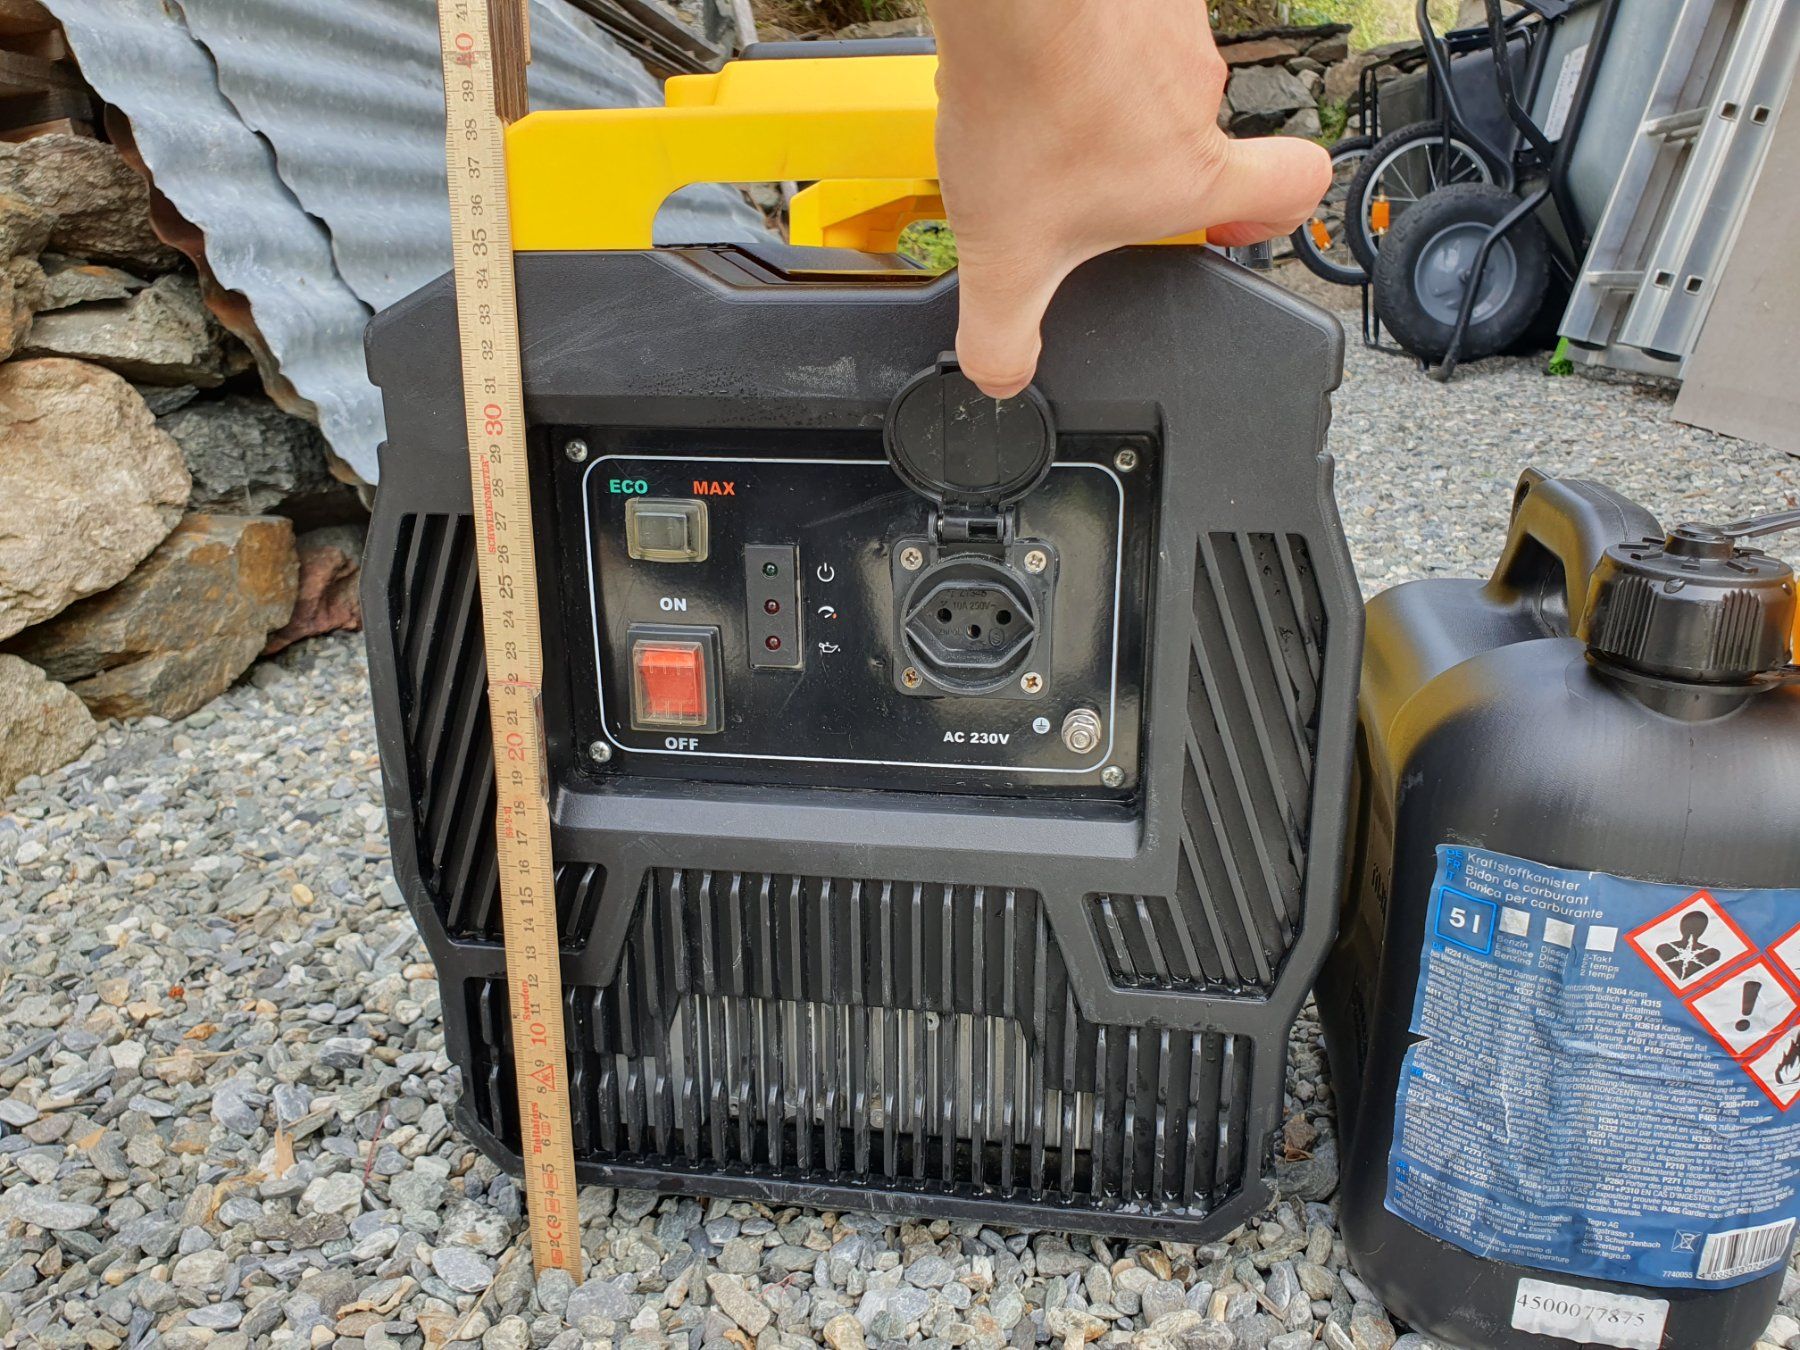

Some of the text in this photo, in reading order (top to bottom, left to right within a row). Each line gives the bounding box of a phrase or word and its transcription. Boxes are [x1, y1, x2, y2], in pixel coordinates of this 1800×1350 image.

[457, 2, 468, 20] 41
[455, 33, 475, 70] 40
[462, 80, 475, 102] 39
[466, 118, 478, 140] 38
[468, 157, 480, 179] 37
[471, 194, 483, 216] 36
[473, 229, 488, 256] 35
[478, 268, 489, 290] 34
[480, 304, 491, 325] 33
[482, 340, 494, 361] 32
[485, 376, 496, 394] 31
[484, 403, 503, 436] 30
[490, 444, 501, 464] 29
[492, 478, 504, 497] 28
[610, 480, 648, 494] ECO
[692, 480, 736, 496] MAX
[495, 512, 506, 530] 27
[498, 545, 509, 563] 26
[498, 575, 514, 599] 25
[660, 597, 687, 611] ON
[503, 610, 514, 628] 24
[506, 642, 516, 660] 23
[507, 708, 518, 726] 21
[665, 737, 698, 750] OFF
[943, 732, 1010, 744] AC 230V
[506, 732, 526, 762] 20
[512, 770, 523, 788] 19
[514, 800, 525, 816] 18
[516, 830, 528, 846] 17
[519, 860, 530, 876] 16
[1447, 849, 1580, 891] DE Kraftstoffkanister
[1447, 859, 1589, 906] FR Bidon de carburant
[521, 887, 534, 906] 15
[1446, 871, 1603, 919] IT Tanica per carburante
[524, 917, 534, 933] 14
[1449, 907, 1466, 928] 5
[1497, 935, 1529, 949] Benzin
[526, 946, 536, 960] 13
[1494, 950, 1532, 966] Benzina
[1496, 943, 1534, 958] Essence
[1540, 946, 1569, 960] Diesel
[1583, 954, 1612, 963] 2-Takt
[1581, 960, 1620, 973] 2 temps
[528, 974, 538, 988] 12
[1498, 967, 1648, 998] und Dampf H304 Kann
[1590, 970, 1616, 980] tempi
[1484, 970, 1662, 1008] und Eindringen tödlich H315
[1514, 986, 1534, 997] H332
[521, 980, 531, 1021] Sweden
[1505, 992, 1663, 1023] und H340 Kann
[530, 1004, 540, 1016] 11
[1472, 997, 1487, 1006] Kind
[1594, 1026, 1613, 1034] Kann
[1628, 1029, 1655, 1039] Organe
[1656, 1032, 1694, 1042] schädigen
[1535, 1008, 1681, 1033] H350 H361d Kann
[530, 1023, 546, 1047] 10
[1626, 1037, 1646, 1045] P101
[1644, 1046, 1664, 1055] P102
[1665, 1050, 1682, 1058] Darf
[539, 1112, 548, 1120] 7
[1698, 1114, 1717, 1122] P405
[1620, 1119, 1636, 1127] Peut
[1653, 1124, 1678, 1132] mortel
[1587, 1138, 1606, 1146] H411
[1608, 1132, 1661, 1146] Peut provoquer
[542, 1164, 554, 1174] 5
[1665, 1161, 1685, 1170] P210
[1662, 1206, 1680, 1214] P405
[1587, 1218, 1606, 1227] Tegro
[1503, 1228, 1516, 1236] pas
[1585, 1226, 1628, 1238] Ringstrasse
[1582, 1240, 1624, 1252] Switzerland
[1604, 1235, 1661, 1248] Schwerzenbach
[1527, 1252, 1569, 1263] temperature
[1581, 1248, 1631, 1260] www.tegro.ch
[1517, 1293, 1645, 1326] 4500077875
